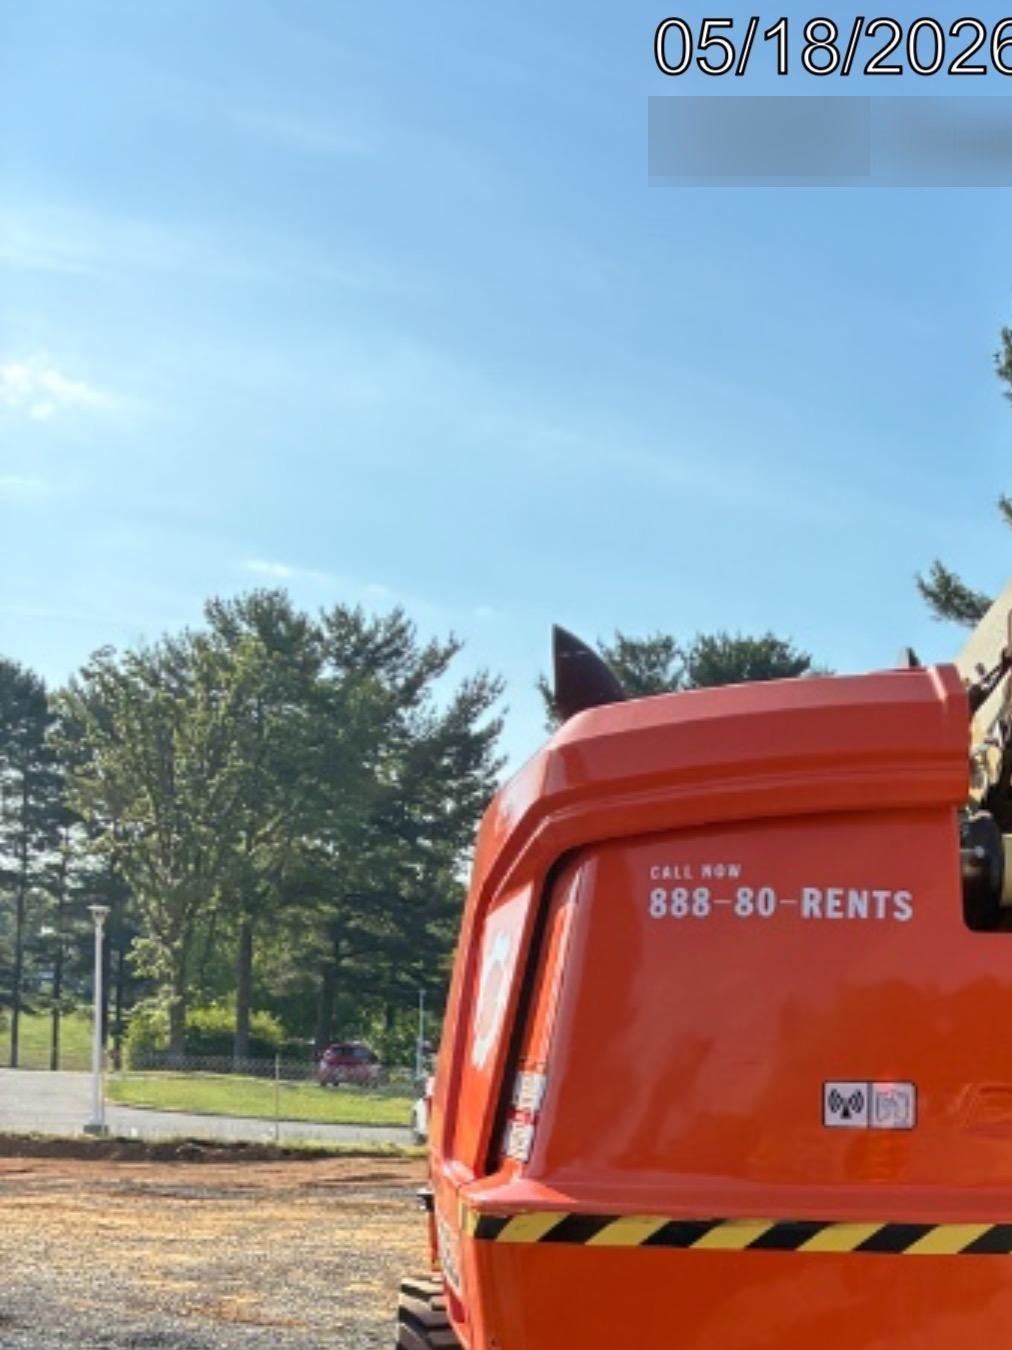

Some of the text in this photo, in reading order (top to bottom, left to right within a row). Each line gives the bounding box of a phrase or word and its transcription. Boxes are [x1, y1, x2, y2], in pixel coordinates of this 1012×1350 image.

[650, 863, 741, 880] CALL NOW
[649, 886, 914, 922] 888-80-RENTS
